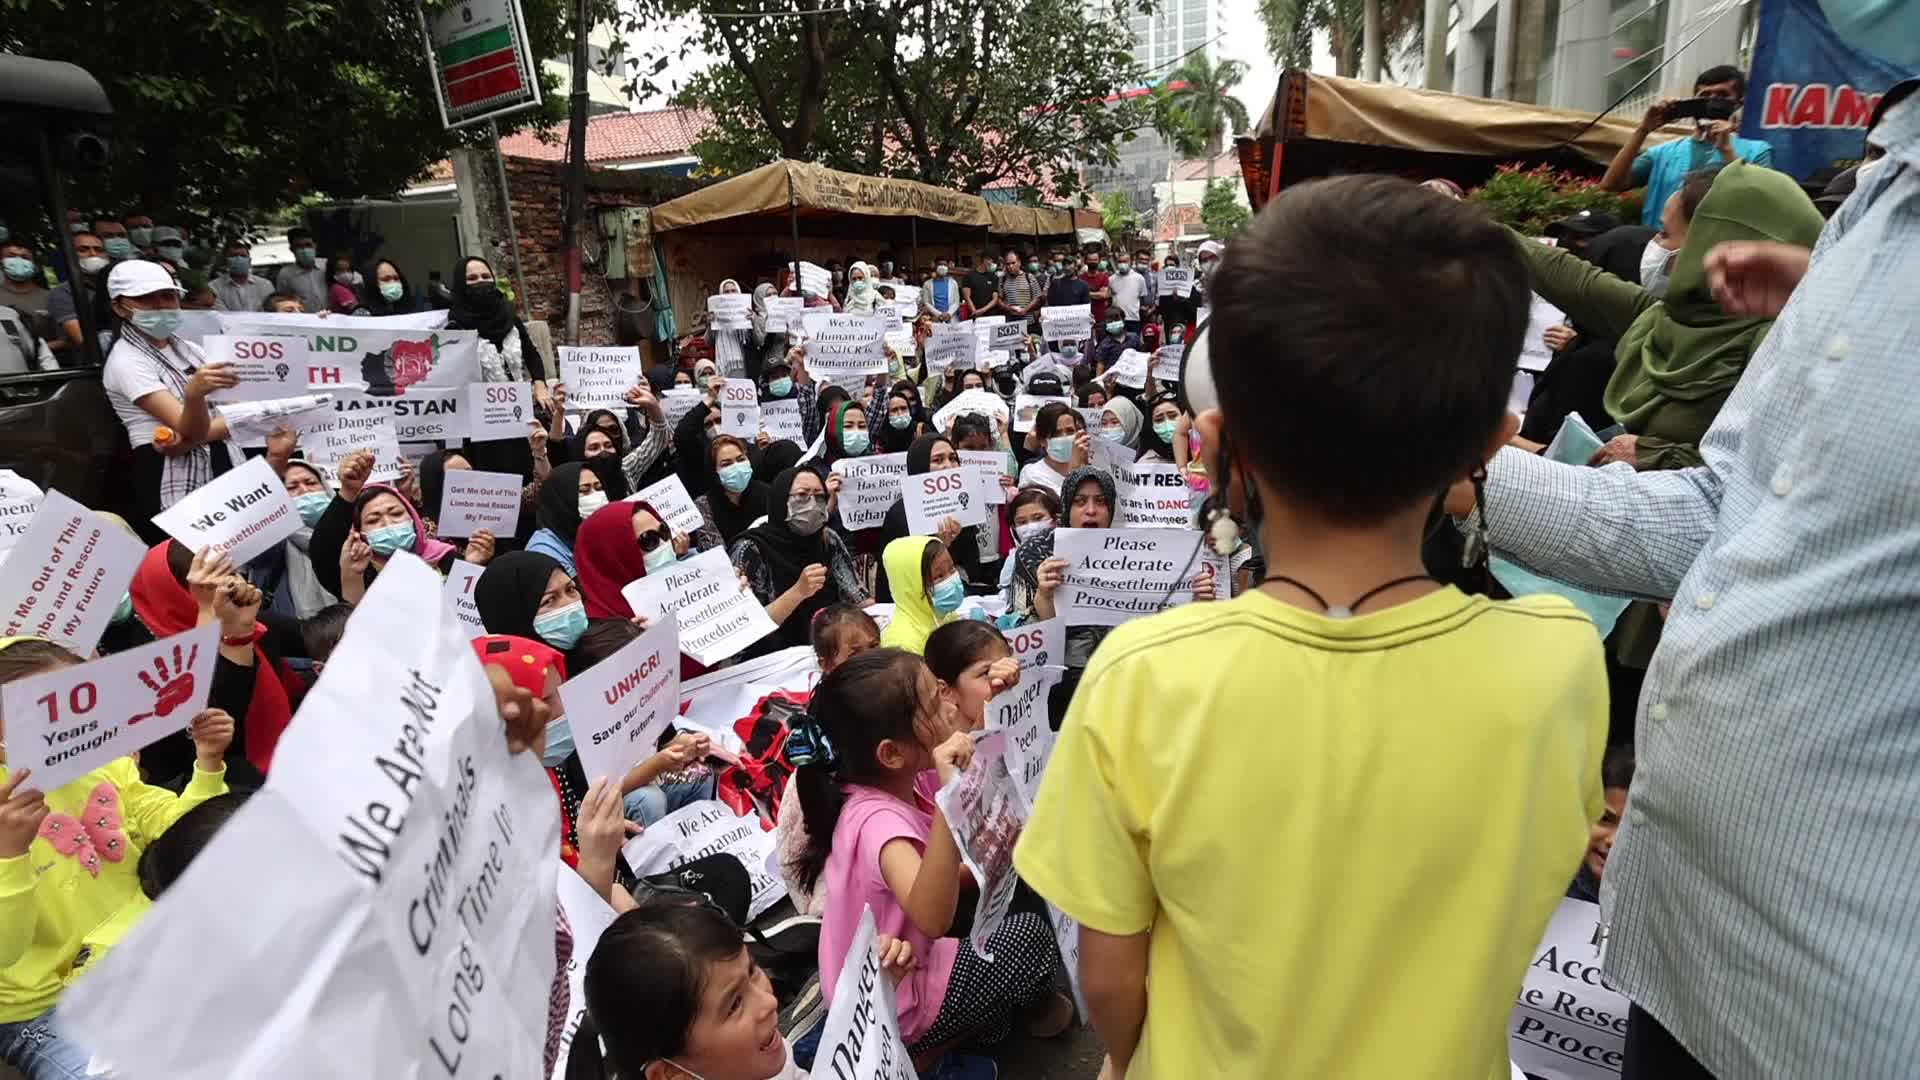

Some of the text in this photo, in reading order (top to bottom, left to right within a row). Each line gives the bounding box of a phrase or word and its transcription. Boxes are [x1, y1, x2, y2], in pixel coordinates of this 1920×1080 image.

[829, 319, 865, 328] We Are
[998, 324, 1019, 337] SOS
[816, 331, 879, 342] Human and
[234, 341, 284, 359] SOS
[567, 351, 633, 364] Life Danger
[578, 366, 622, 375] Has Been
[809, 358, 883, 368] Humanitarian
[580, 378, 625, 388] Proved in
[486, 387, 518, 404] SOS
[727, 388, 754, 401] SOS
[338, 415, 386, 431] Danger
[326, 433, 376, 448] Has Been
[844, 465, 867, 478] Life
[1121, 469, 1151, 487] WANT
[1154, 474, 1188, 487] RES
[451, 486, 464, 495] Get
[480, 488, 493, 496] Out
[857, 480, 876, 491] Has
[923, 473, 962, 495] SOS
[190, 482, 273, 533] We Want
[857, 493, 892, 505] Proved
[1129, 500, 1143, 509] are
[1145, 498, 1155, 509] in
[1141, 513, 1188, 525] Refugees
[1103, 536, 1157, 551] Please
[53, 582, 73, 610] and
[68, 528, 101, 580] Rescue
[1078, 555, 1174, 572] Accelerate
[5, 515, 82, 637] et Me Out of This
[463, 575, 474, 594] 1
[665, 567, 703, 592] Please
[1090, 576, 1193, 592] Resettlement
[63, 567, 106, 637] My Future
[658, 580, 721, 616] Accelerate
[678, 592, 748, 632] Resettlement
[681, 614, 750, 652] Procedures
[604, 650, 661, 705] UNHCR!
[37, 681, 97, 723] 10
[42, 719, 99, 747] Years
[592, 720, 622, 745] Save
[624, 705, 639, 725] our
[629, 710, 656, 743] Future
[44, 727, 119, 767] enough!
[1016, 725, 1039, 754] een
[678, 818, 699, 838] We
[336, 801, 404, 884] We
[408, 756, 475, 956] Criminals
[428, 940, 484, 1077] Long
[457, 841, 503, 945] Time
